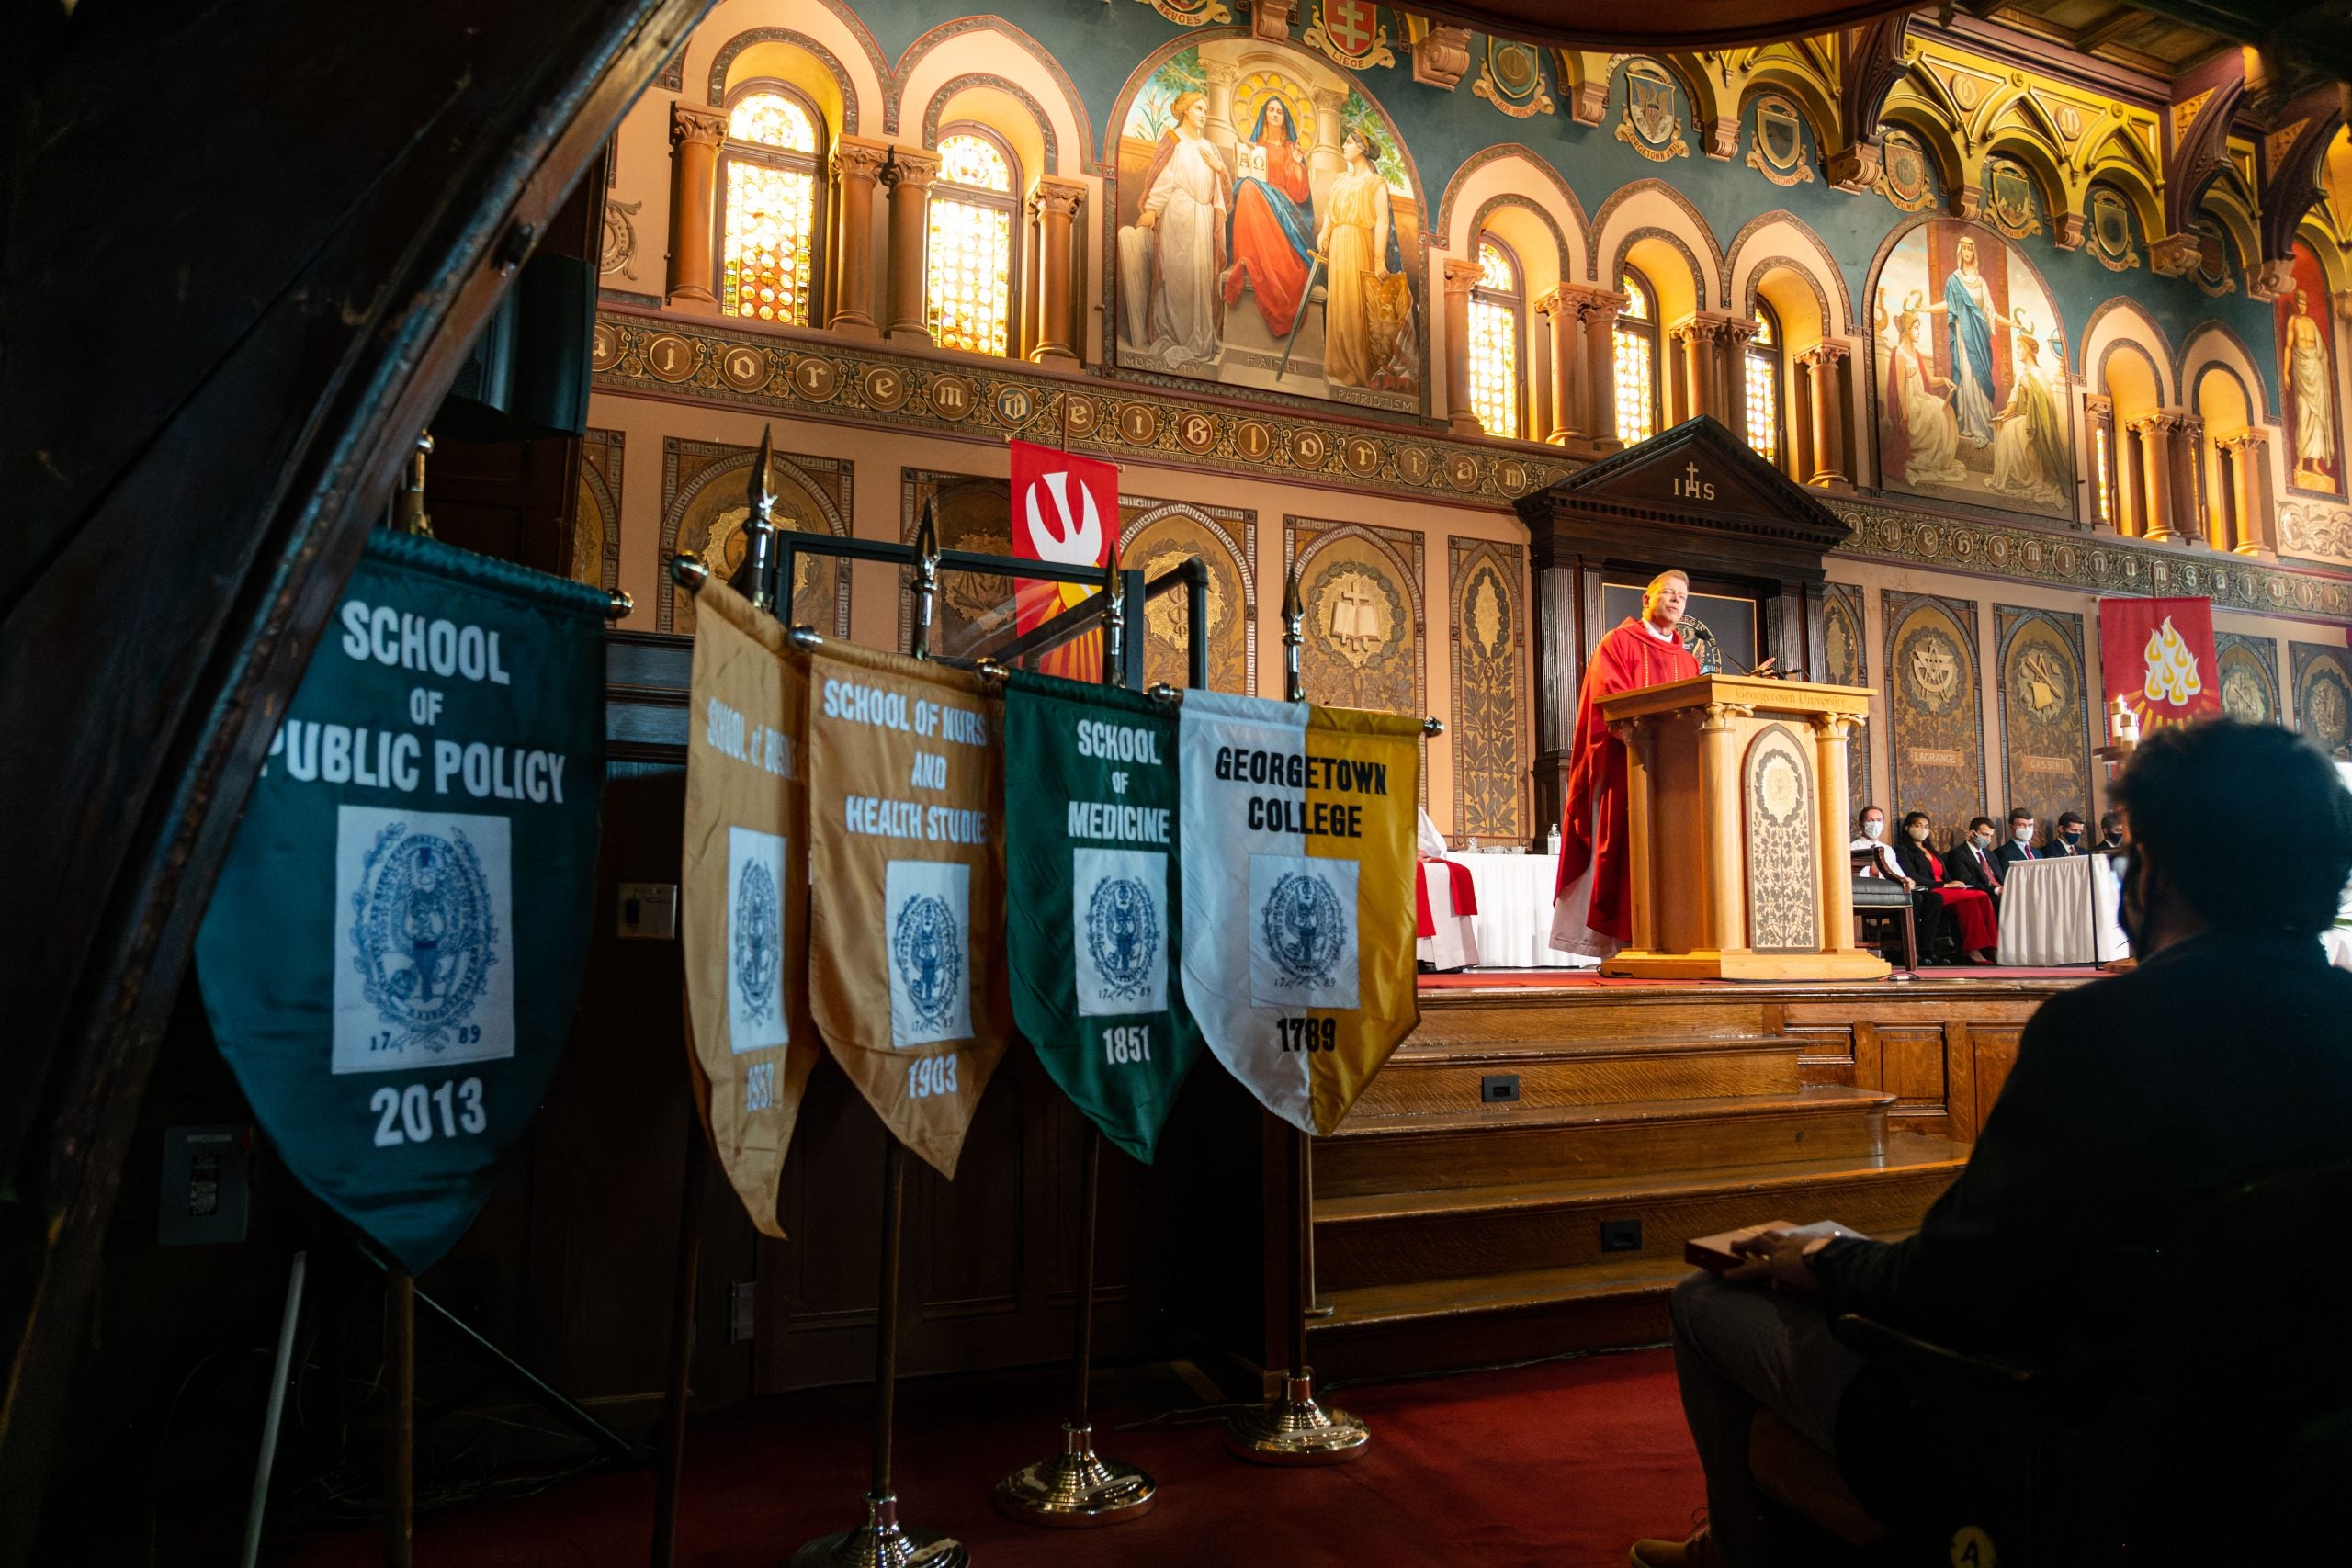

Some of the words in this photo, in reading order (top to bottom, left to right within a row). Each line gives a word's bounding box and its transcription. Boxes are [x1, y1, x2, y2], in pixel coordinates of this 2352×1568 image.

[1895, 199, 1916, 211] ROME
[1338, 389, 1413, 412] PATRIOTISM
[1673, 477, 1715, 501] IHS
[341, 600, 510, 686] SCHOOL
[409, 688, 443, 726] OF
[823, 677, 910, 732] SCHOOL
[914, 698, 940, 738] OF
[1735, 686, 1795, 705] Georgetown
[1798, 691, 1847, 708] University
[1077, 718, 1162, 766] SCHOOL
[1914, 751, 1956, 764] LAGRANGE
[435, 739, 566, 804] POLICY
[910, 750, 947, 790] AND
[1112, 770, 1129, 795] OF
[1215, 746, 1389, 796] GEORGETOWN
[2030, 760, 2064, 771] CASSINI
[845, 794, 923, 840] HEALTH
[1068, 799, 1171, 845] MEDICINE
[1248, 795, 1363, 840] COLLEGE
[1102, 1024, 1151, 1066] 1851
[1276, 1017, 1337, 1053] 1789
[908, 1052, 957, 1100] 1903
[371, 1077, 487, 1148] 2013
